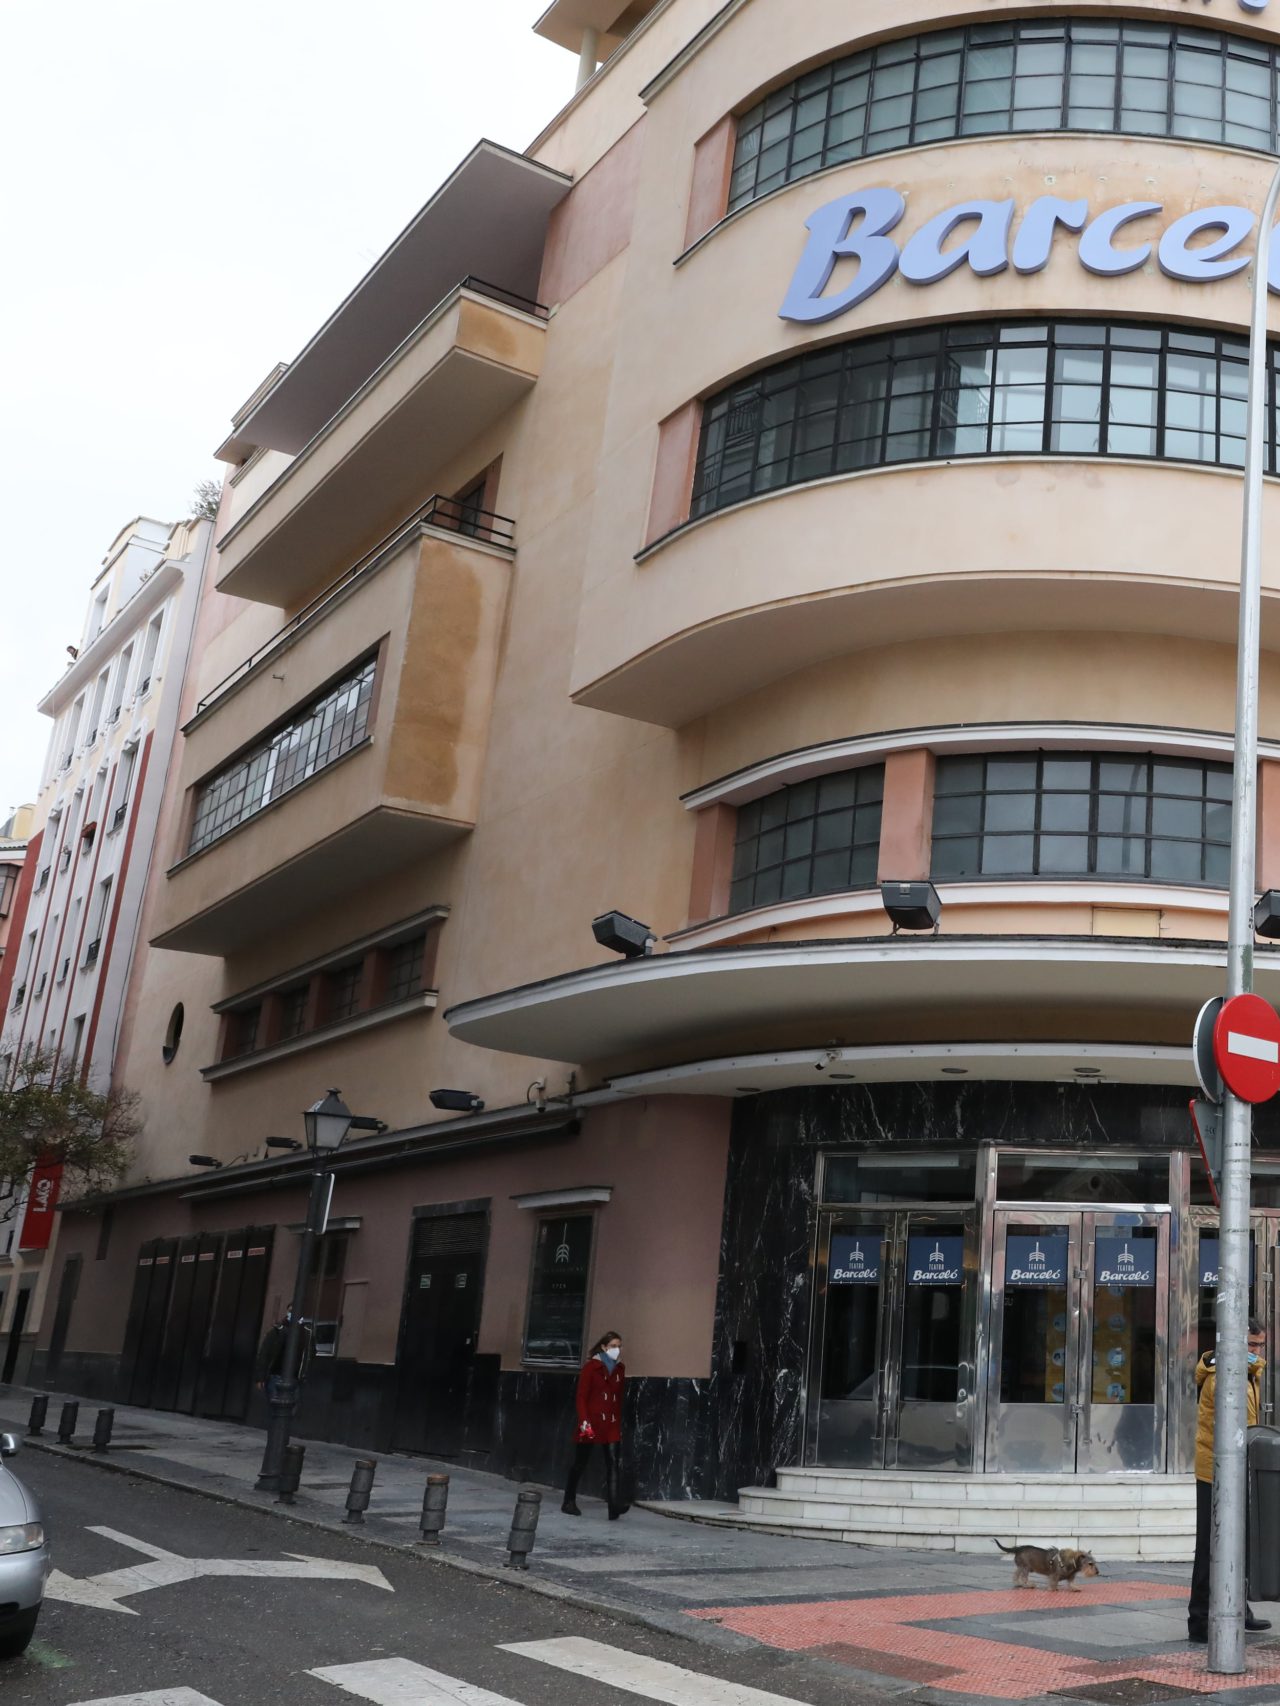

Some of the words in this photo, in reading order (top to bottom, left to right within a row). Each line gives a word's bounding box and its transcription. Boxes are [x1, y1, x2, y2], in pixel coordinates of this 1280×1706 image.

[833, 1268, 878, 1280] Barceló
[913, 1268, 958, 1281] Barceló
[1011, 1269, 1061, 1281] Barceló
[1100, 1270, 1150, 1281] Barceló
